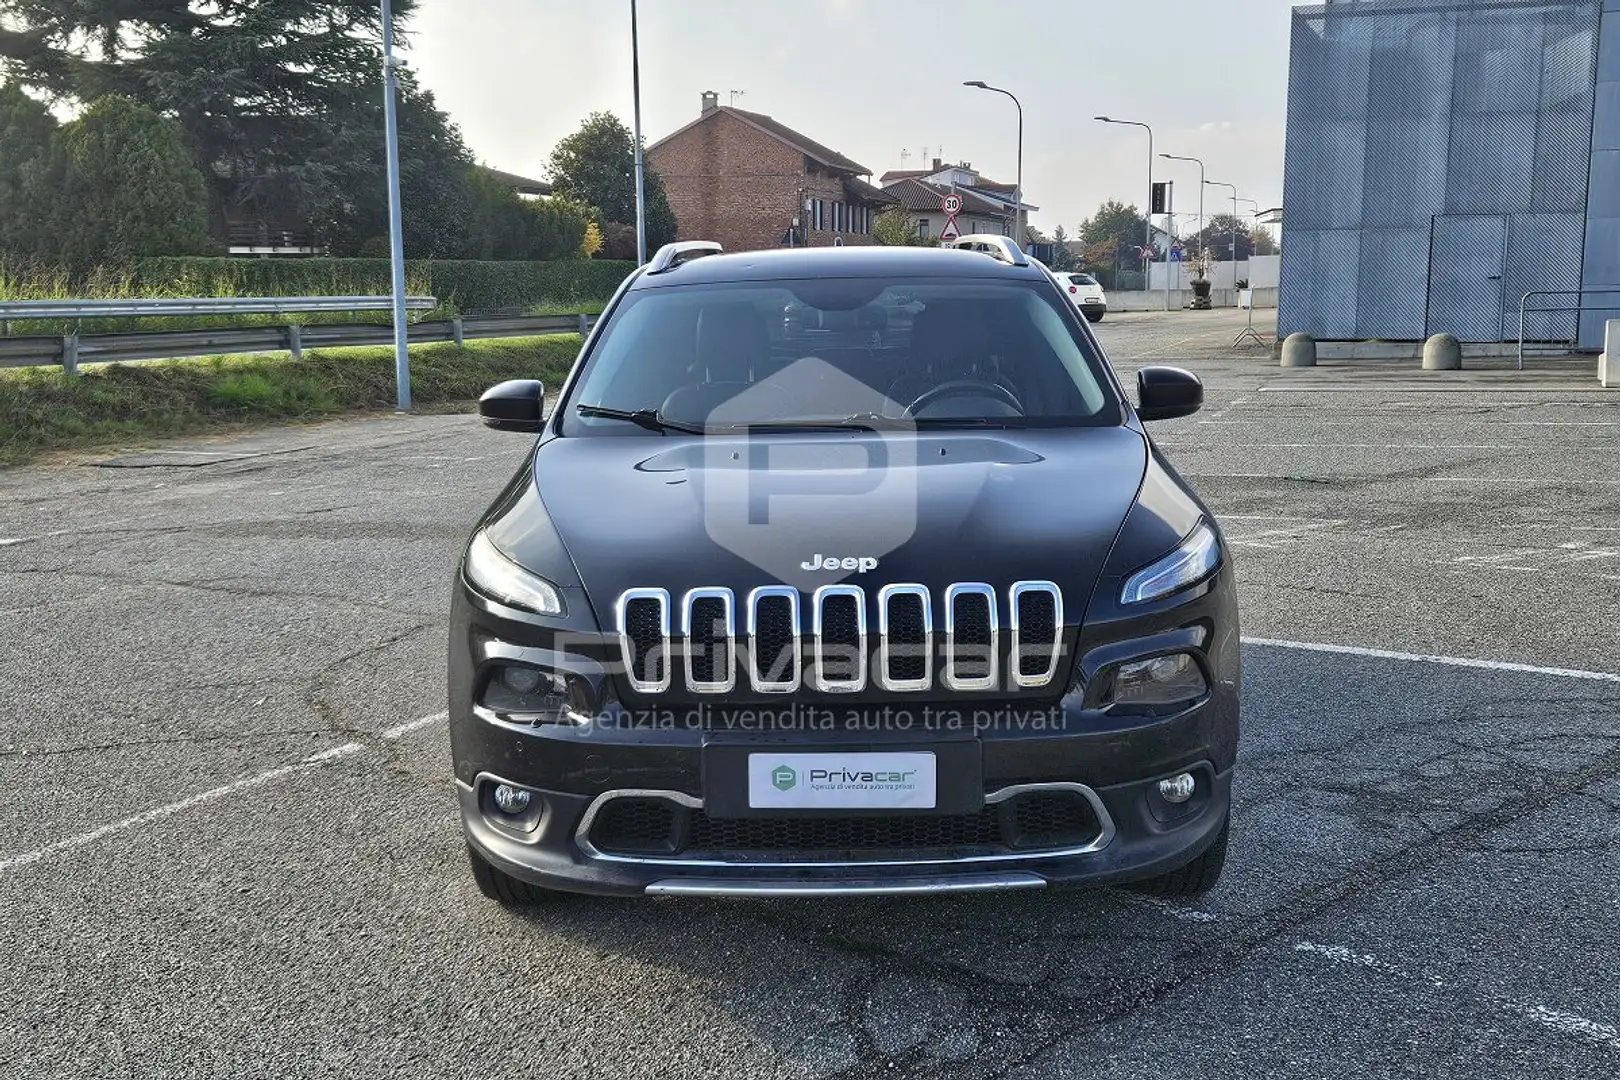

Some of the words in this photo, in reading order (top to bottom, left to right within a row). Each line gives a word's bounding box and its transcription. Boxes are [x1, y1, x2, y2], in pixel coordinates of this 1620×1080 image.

[946, 199, 957, 209] 30
[800, 553, 878, 573] Jeep
[810, 767, 914, 782] Privacar
